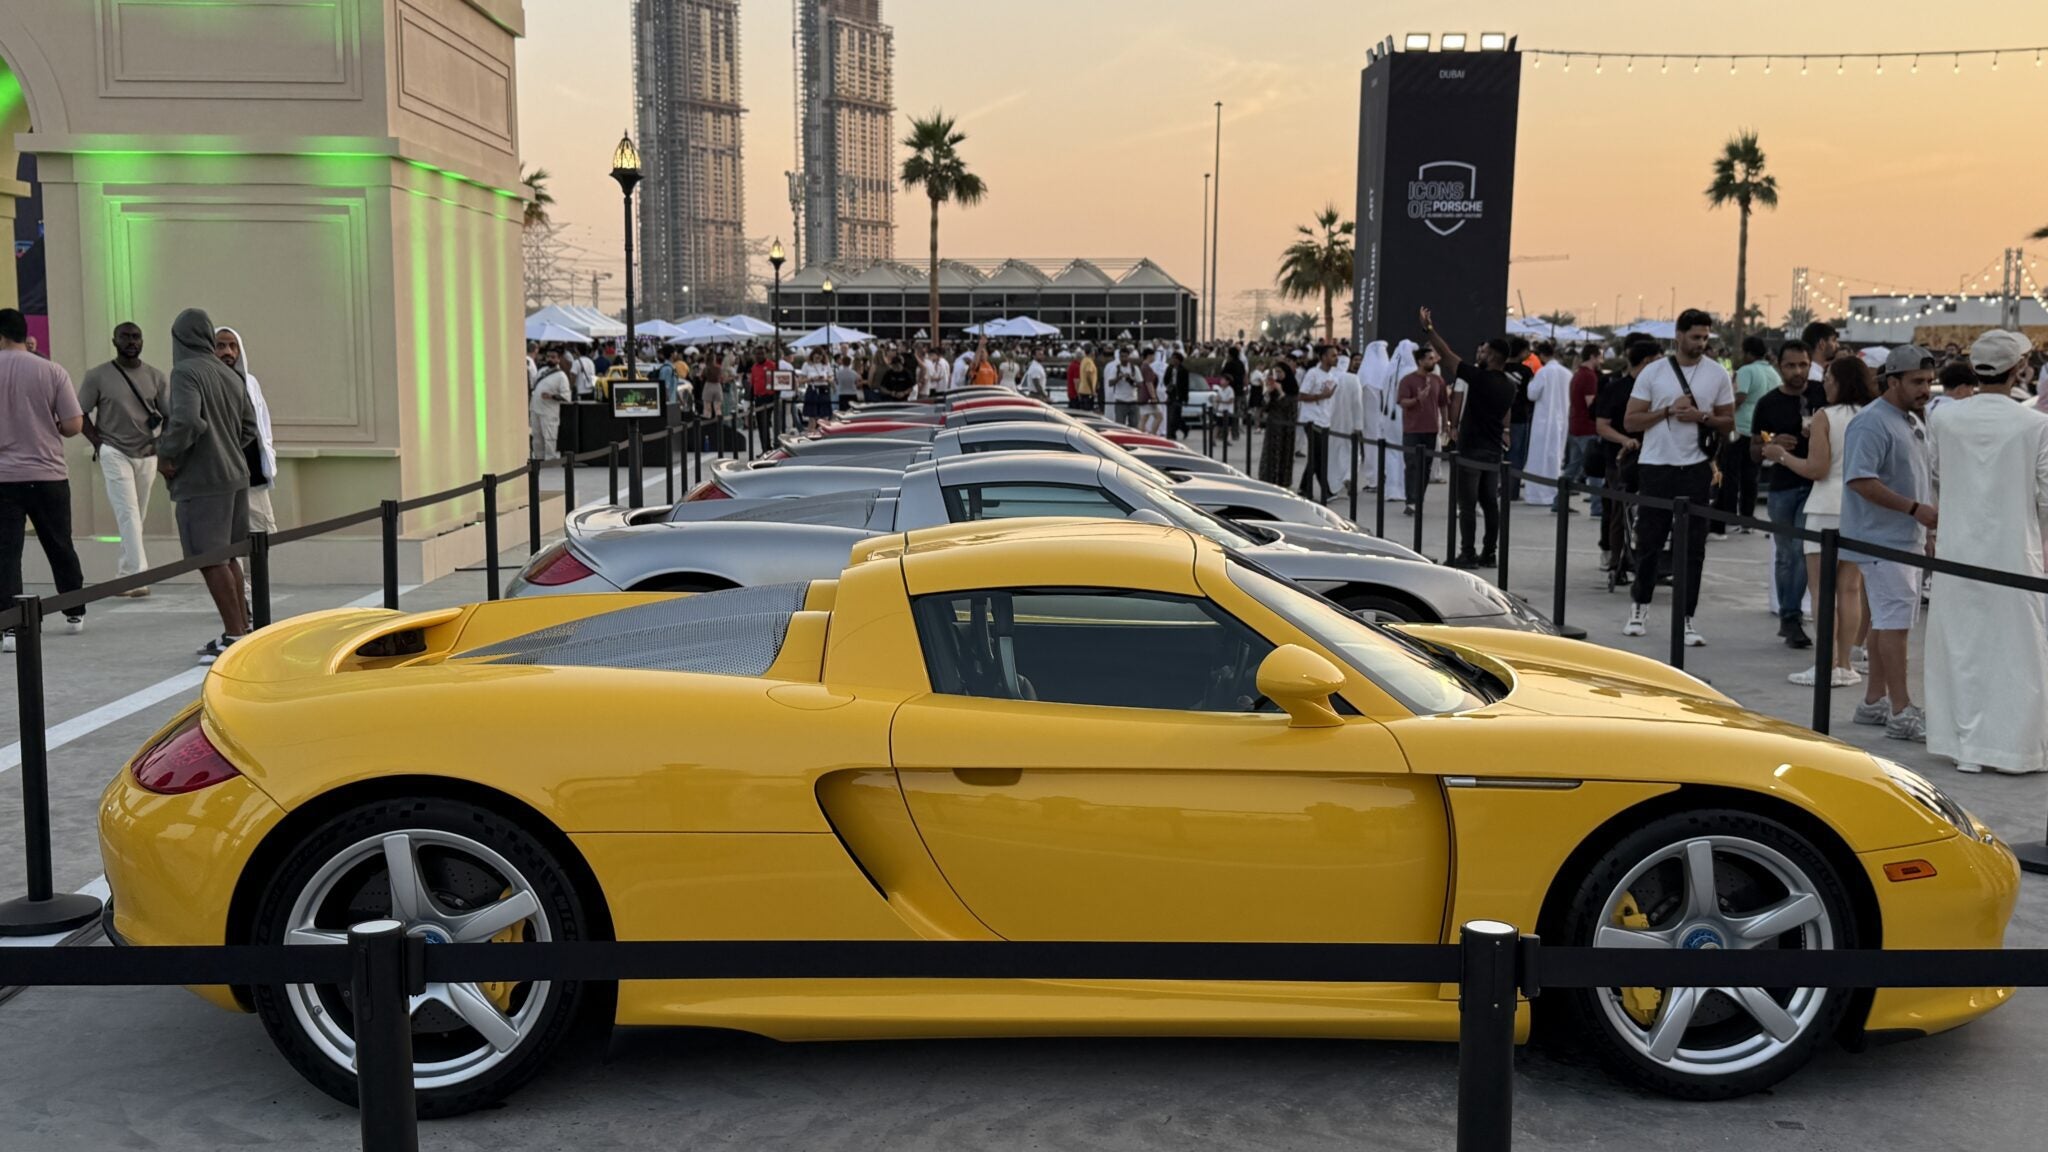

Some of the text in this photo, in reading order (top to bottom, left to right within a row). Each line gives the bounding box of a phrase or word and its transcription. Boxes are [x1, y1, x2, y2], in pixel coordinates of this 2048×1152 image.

[1439, 69, 1465, 79] DUBAI
[1408, 181, 1464, 200] ICONS
[1408, 200, 1483, 219] OF PORSCHE
[1367, 242, 1377, 322] CULTURE
[1359, 278, 1367, 325] CARS
